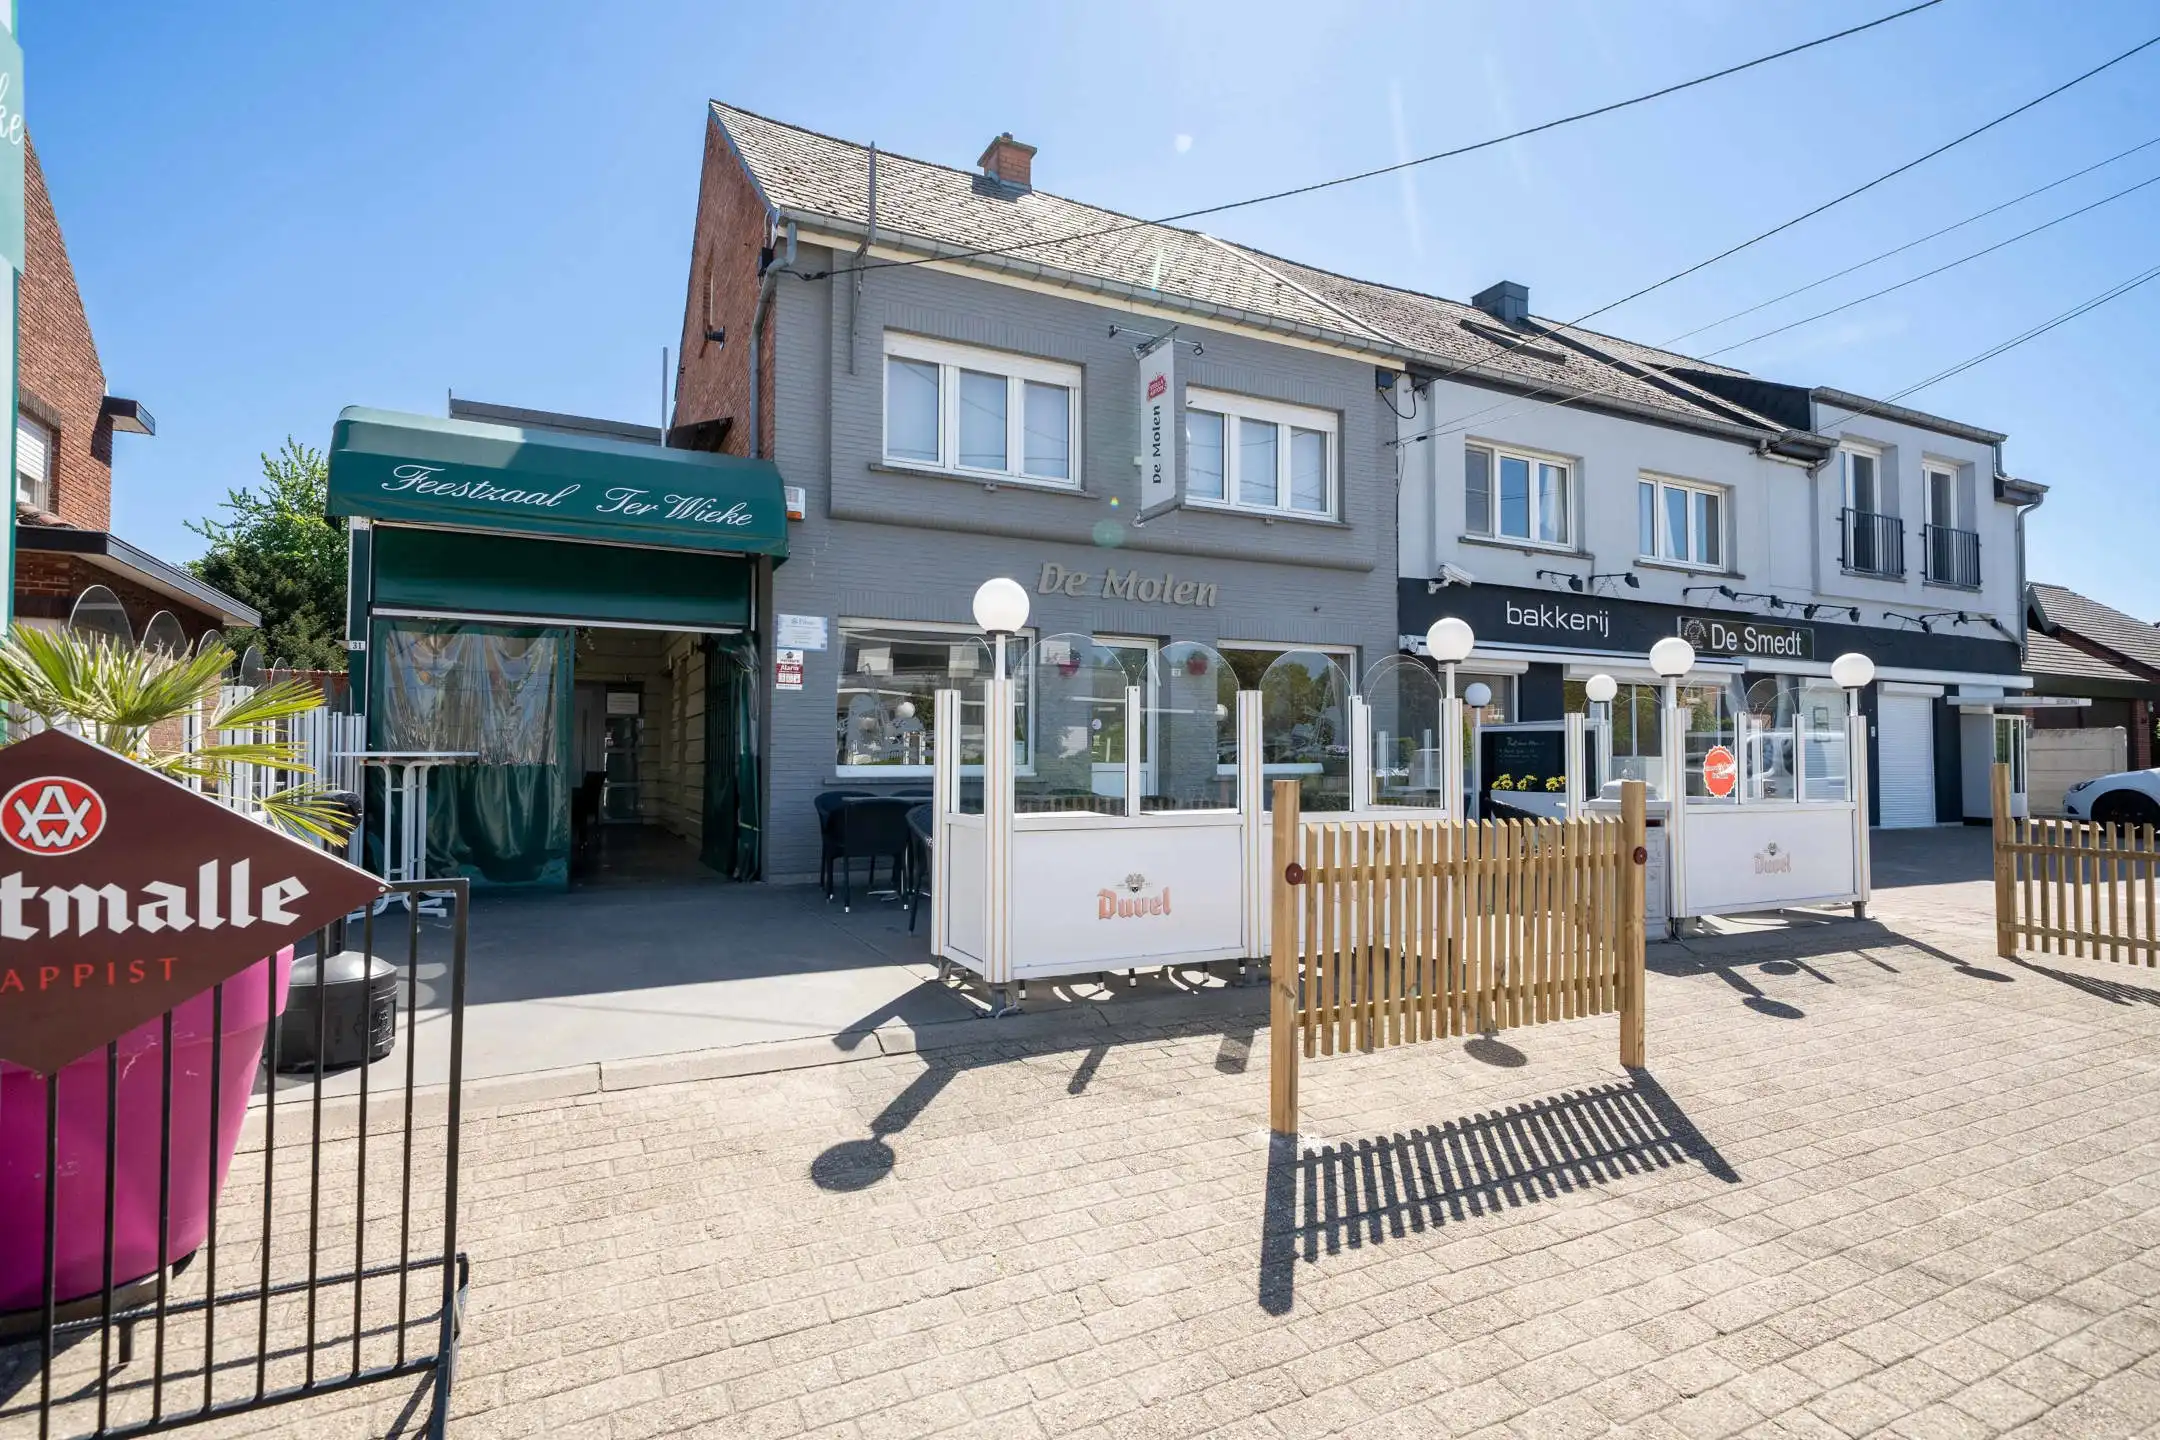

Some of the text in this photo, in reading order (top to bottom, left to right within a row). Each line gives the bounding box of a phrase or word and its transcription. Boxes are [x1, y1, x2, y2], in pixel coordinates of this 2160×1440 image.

[1152, 405, 1161, 457] Molen
[1152, 464, 1161, 483] De
[381, 464, 753, 526] Feestzaal Ter Wieke
[1037, 562, 1218, 607] De Molen
[1506, 600, 1609, 638] bakkerij
[352, 641, 362, 650] 31
[1711, 623, 1802, 656] De Smedt
[0, 858, 310, 941] tmalle
[1097, 886, 1171, 920] Duvel
[1, 958, 179, 993] APPIST
